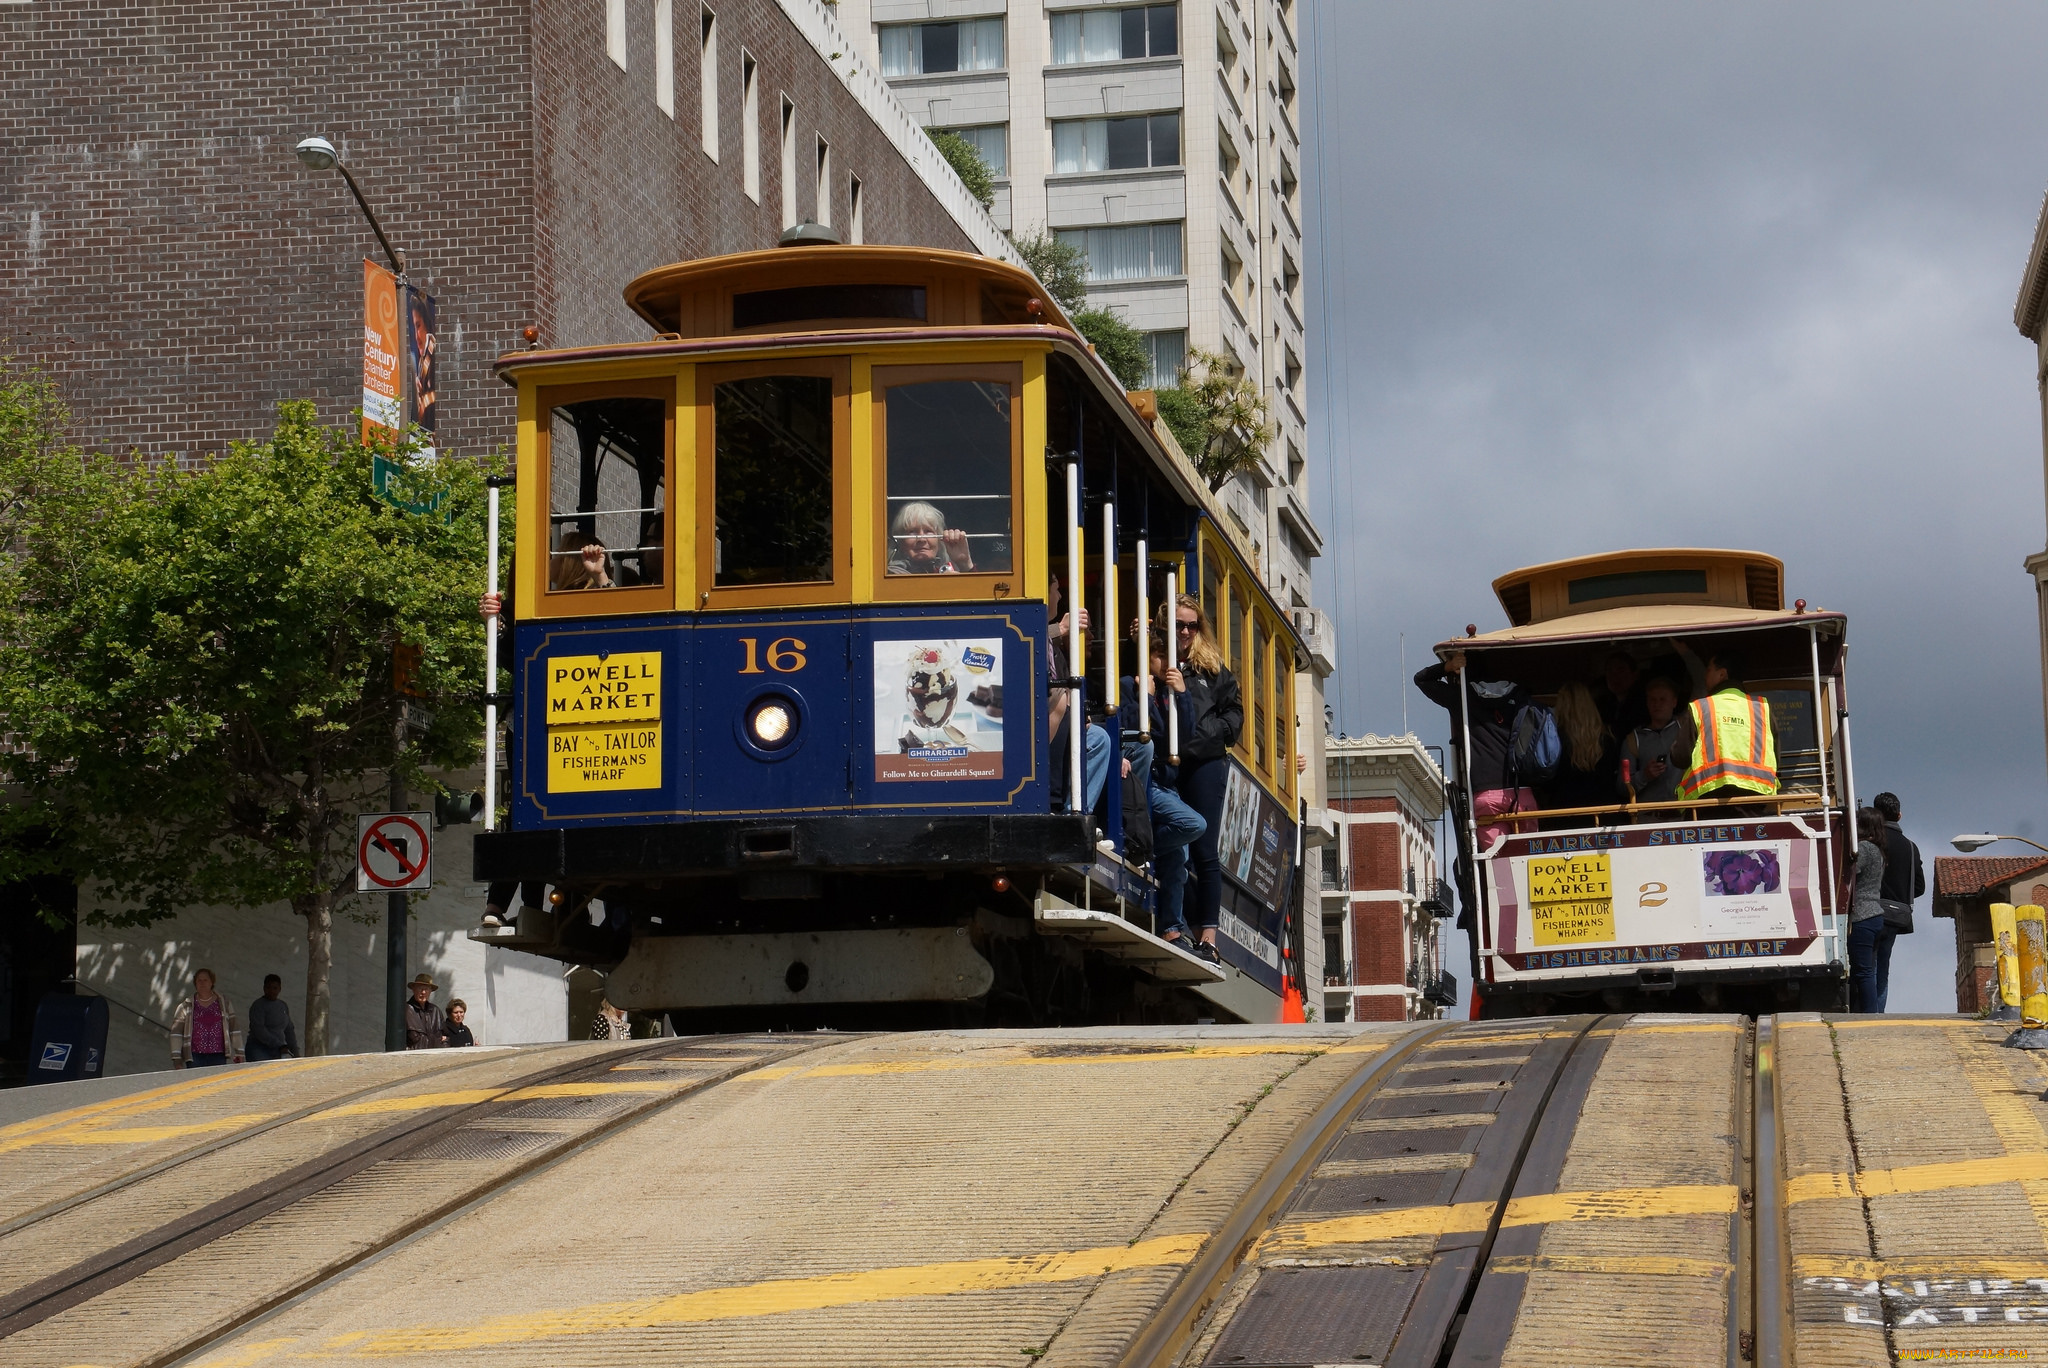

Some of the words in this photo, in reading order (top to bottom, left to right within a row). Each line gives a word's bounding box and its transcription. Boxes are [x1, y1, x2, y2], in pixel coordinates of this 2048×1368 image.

[365, 326, 381, 345] New
[364, 342, 396, 370] Century
[364, 359, 392, 380] Chamber
[364, 373, 394, 395] Orchestra
[738, 637, 807, 674] 16
[555, 664, 654, 683] POWELL
[581, 682, 629, 694] AND
[552, 693, 655, 712] MARKET
[410, 709, 431, 726] POWELL
[1722, 716, 1745, 725] SFMTA
[554, 735, 578, 752] BAY
[585, 736, 599, 751] AND
[604, 732, 656, 750] TAYLOR
[563, 754, 646, 768] FISHERMANS
[910, 749, 966, 757] GHIRARDELLI
[583, 768, 626, 781] WHARF
[883, 770, 906, 778] Follow
[908, 770, 919, 778] Me
[930, 769, 968, 777] Ghirardelli
[969, 769, 995, 778] Square!
[1529, 834, 1625, 854] MARKET
[1648, 826, 1745, 845] STREET
[1534, 862, 1605, 876] POWELL
[1554, 874, 1588, 884] AND
[1534, 882, 1608, 896] MARKET
[1639, 882, 1668, 908] 2
[1536, 907, 1553, 919] BAY
[1571, 903, 1610, 916] TAYLOR
[1543, 918, 1604, 930] FISHERMANS
[1558, 928, 1588, 938] WHARF
[1526, 945, 1681, 969] FISHERMANS
[1705, 940, 1788, 958] WHARF
